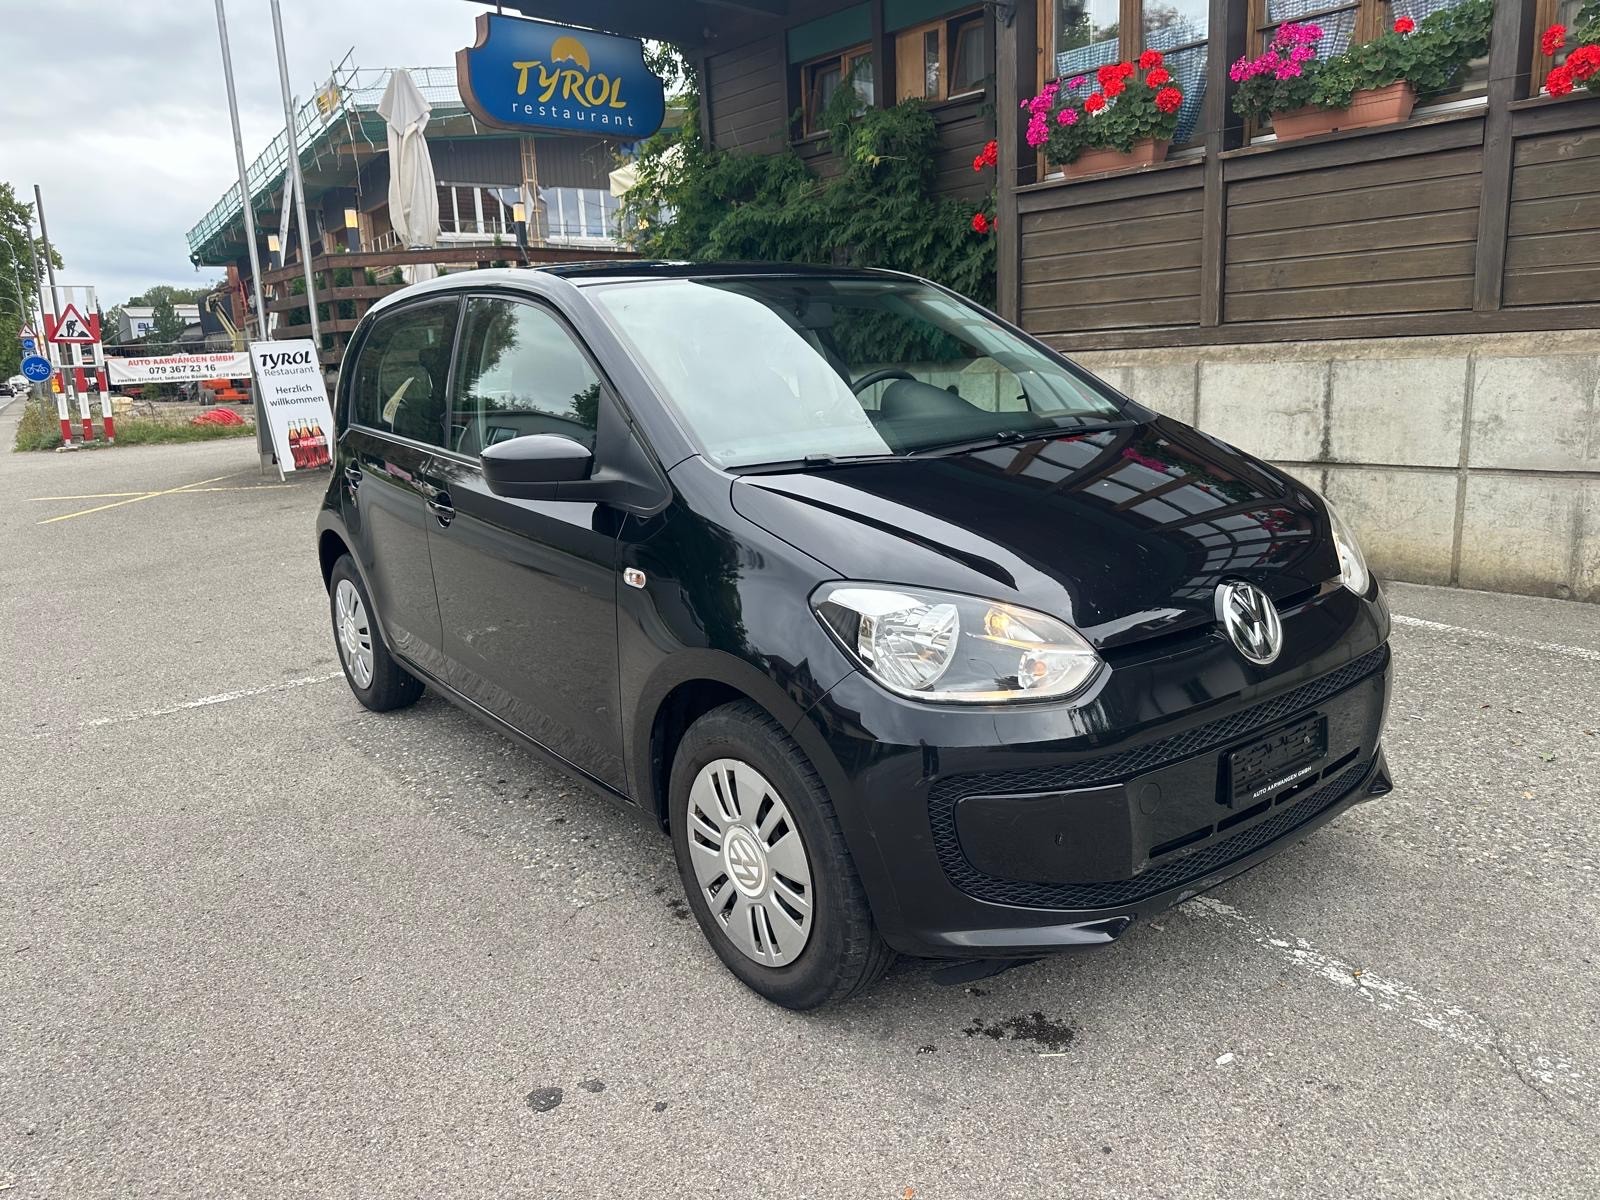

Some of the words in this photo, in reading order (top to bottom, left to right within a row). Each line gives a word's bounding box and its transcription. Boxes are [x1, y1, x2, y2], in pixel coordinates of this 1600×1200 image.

[513, 61, 627, 108] TYROL
[512, 102, 633, 127] restaurant
[128, 359, 151, 367] AUTO
[153, 356, 208, 365] AARWANGEN
[209, 354, 235, 363] GMBH
[259, 350, 312, 370] TYROL
[148, 366, 167, 375] 079
[169, 365, 187, 374] 367
[189, 364, 202, 372] 23
[204, 363, 217, 372] 16
[263, 366, 315, 377] Restaurant
[275, 383, 313, 395] Herzlich
[269, 394, 325, 407] willkommen
[1224, 582, 1281, 664] VW
[1252, 787, 1267, 799] AUTO
[1267, 772, 1298, 791] AARWANGEN
